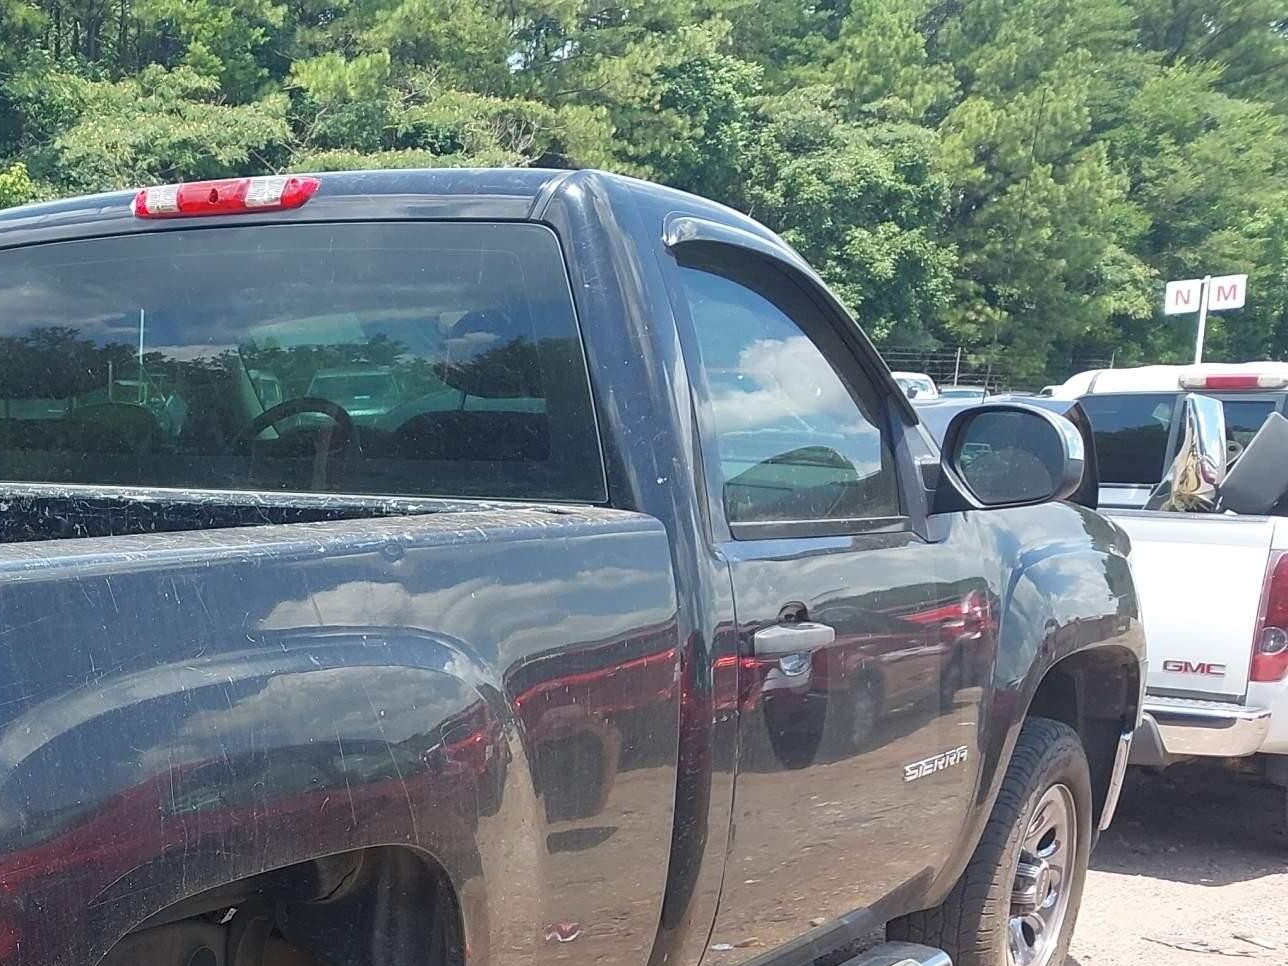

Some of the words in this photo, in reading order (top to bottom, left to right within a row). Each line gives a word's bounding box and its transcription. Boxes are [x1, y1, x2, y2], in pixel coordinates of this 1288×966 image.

[1175, 289, 1191, 306] N
[1216, 284, 1238, 302] M
[1163, 660, 1227, 675] GMC
[903, 744, 969, 782] SIERRA
